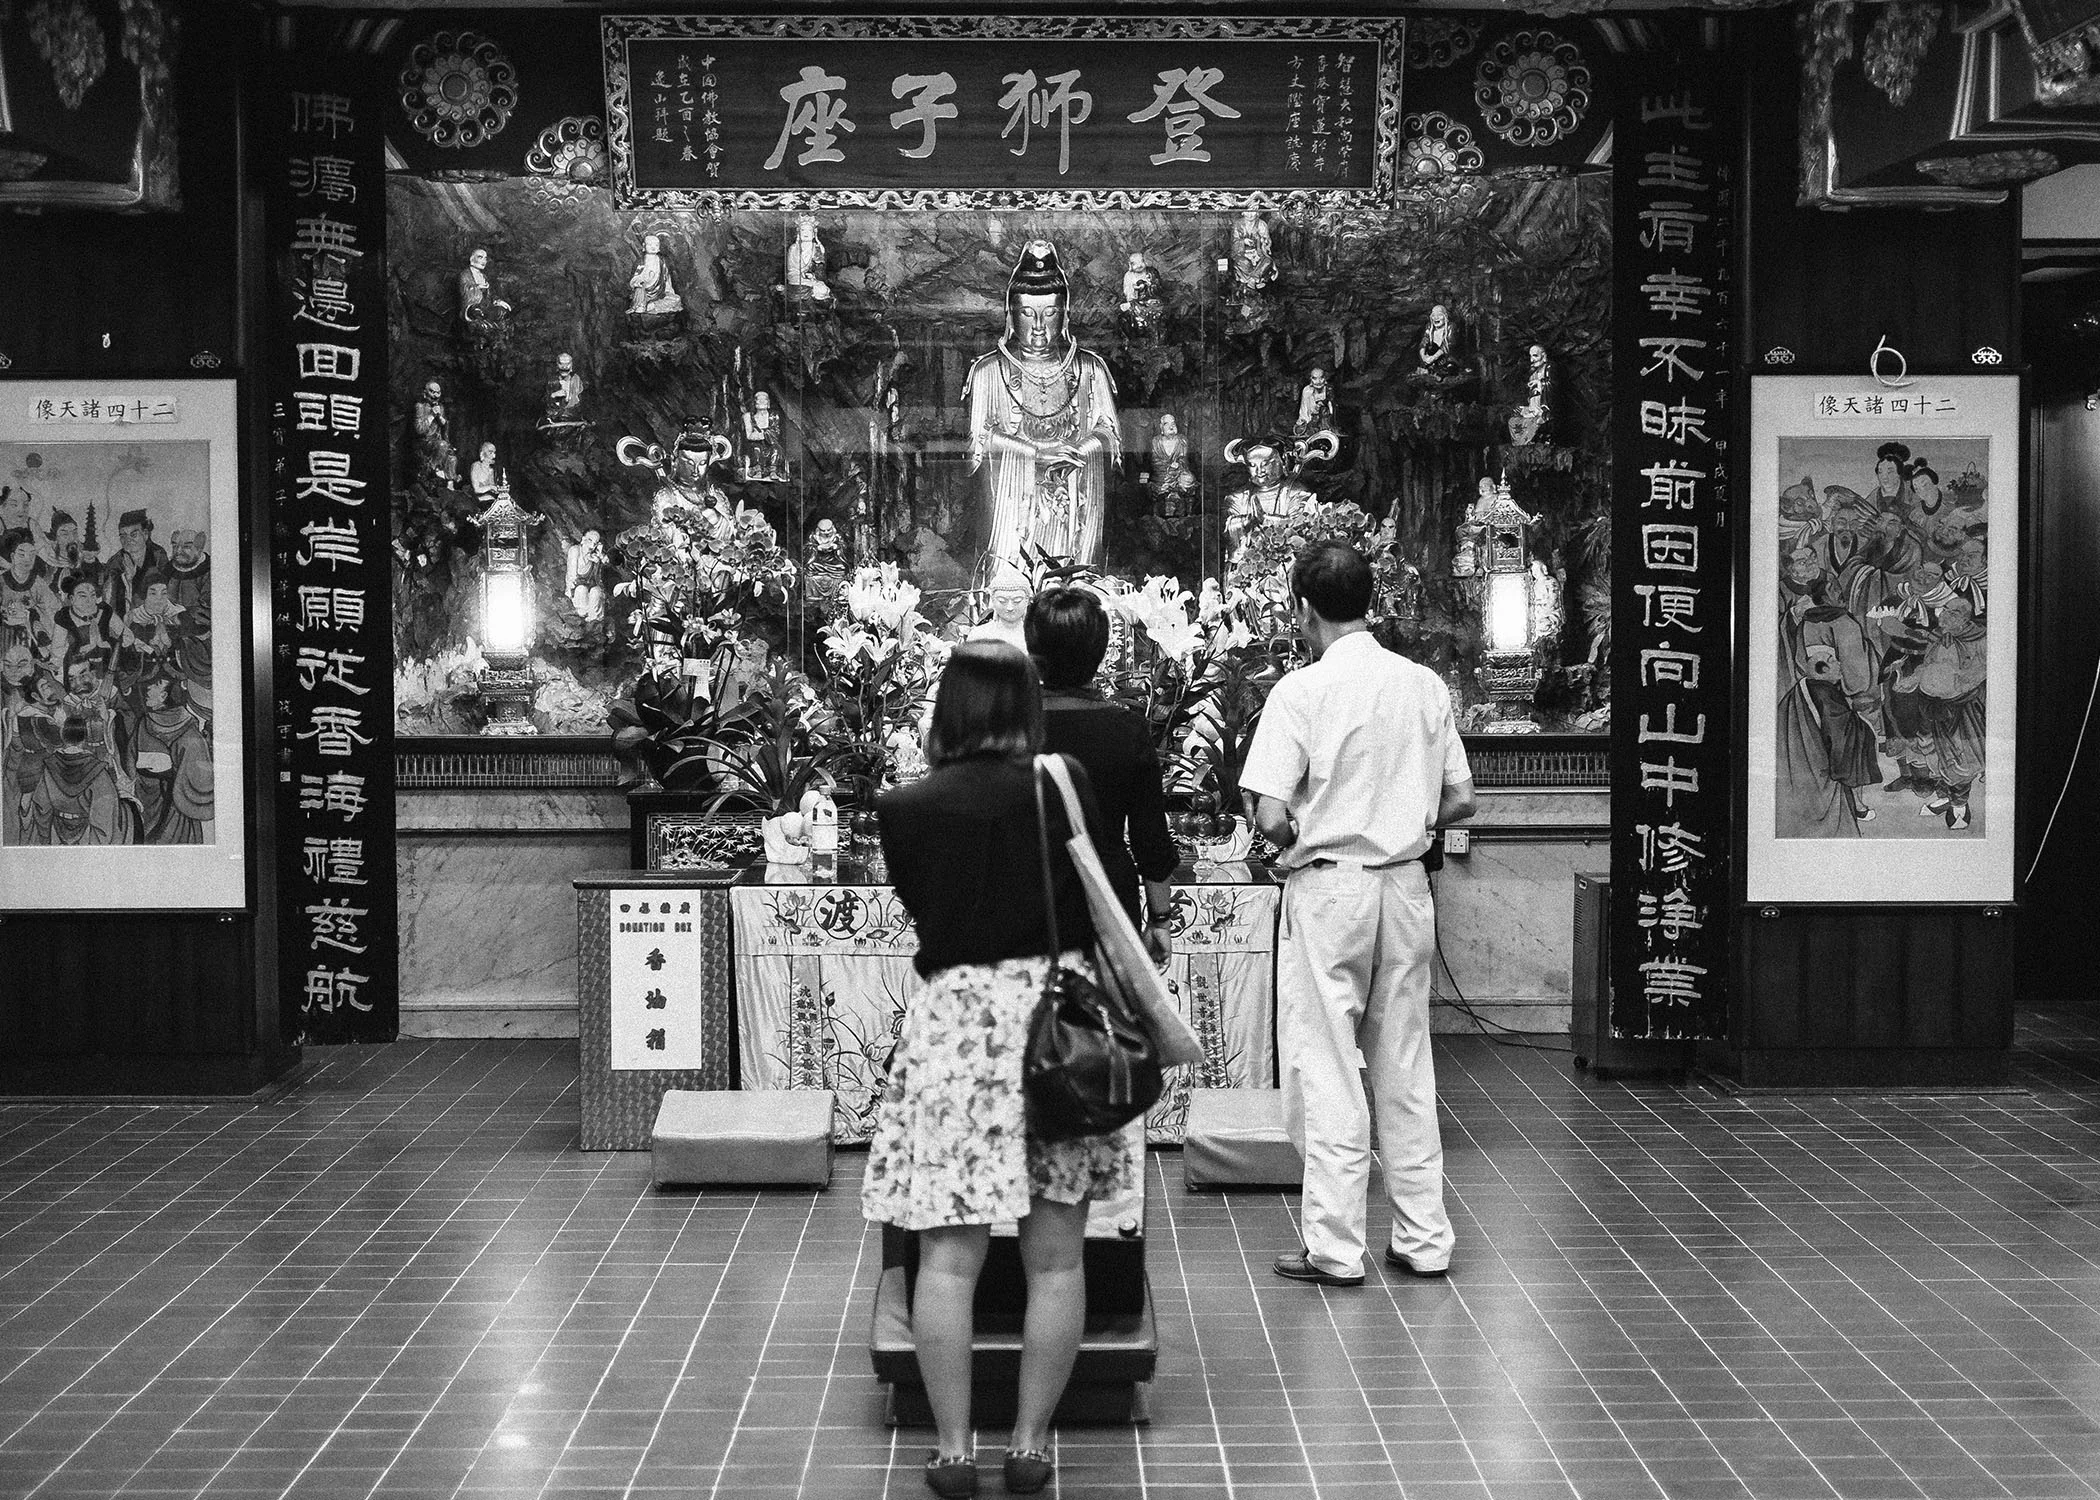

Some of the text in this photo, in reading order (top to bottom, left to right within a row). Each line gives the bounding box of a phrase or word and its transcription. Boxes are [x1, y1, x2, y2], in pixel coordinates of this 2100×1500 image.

[820, 890, 858, 934] 渡
[619, 922, 692, 933] DONATION BOX
